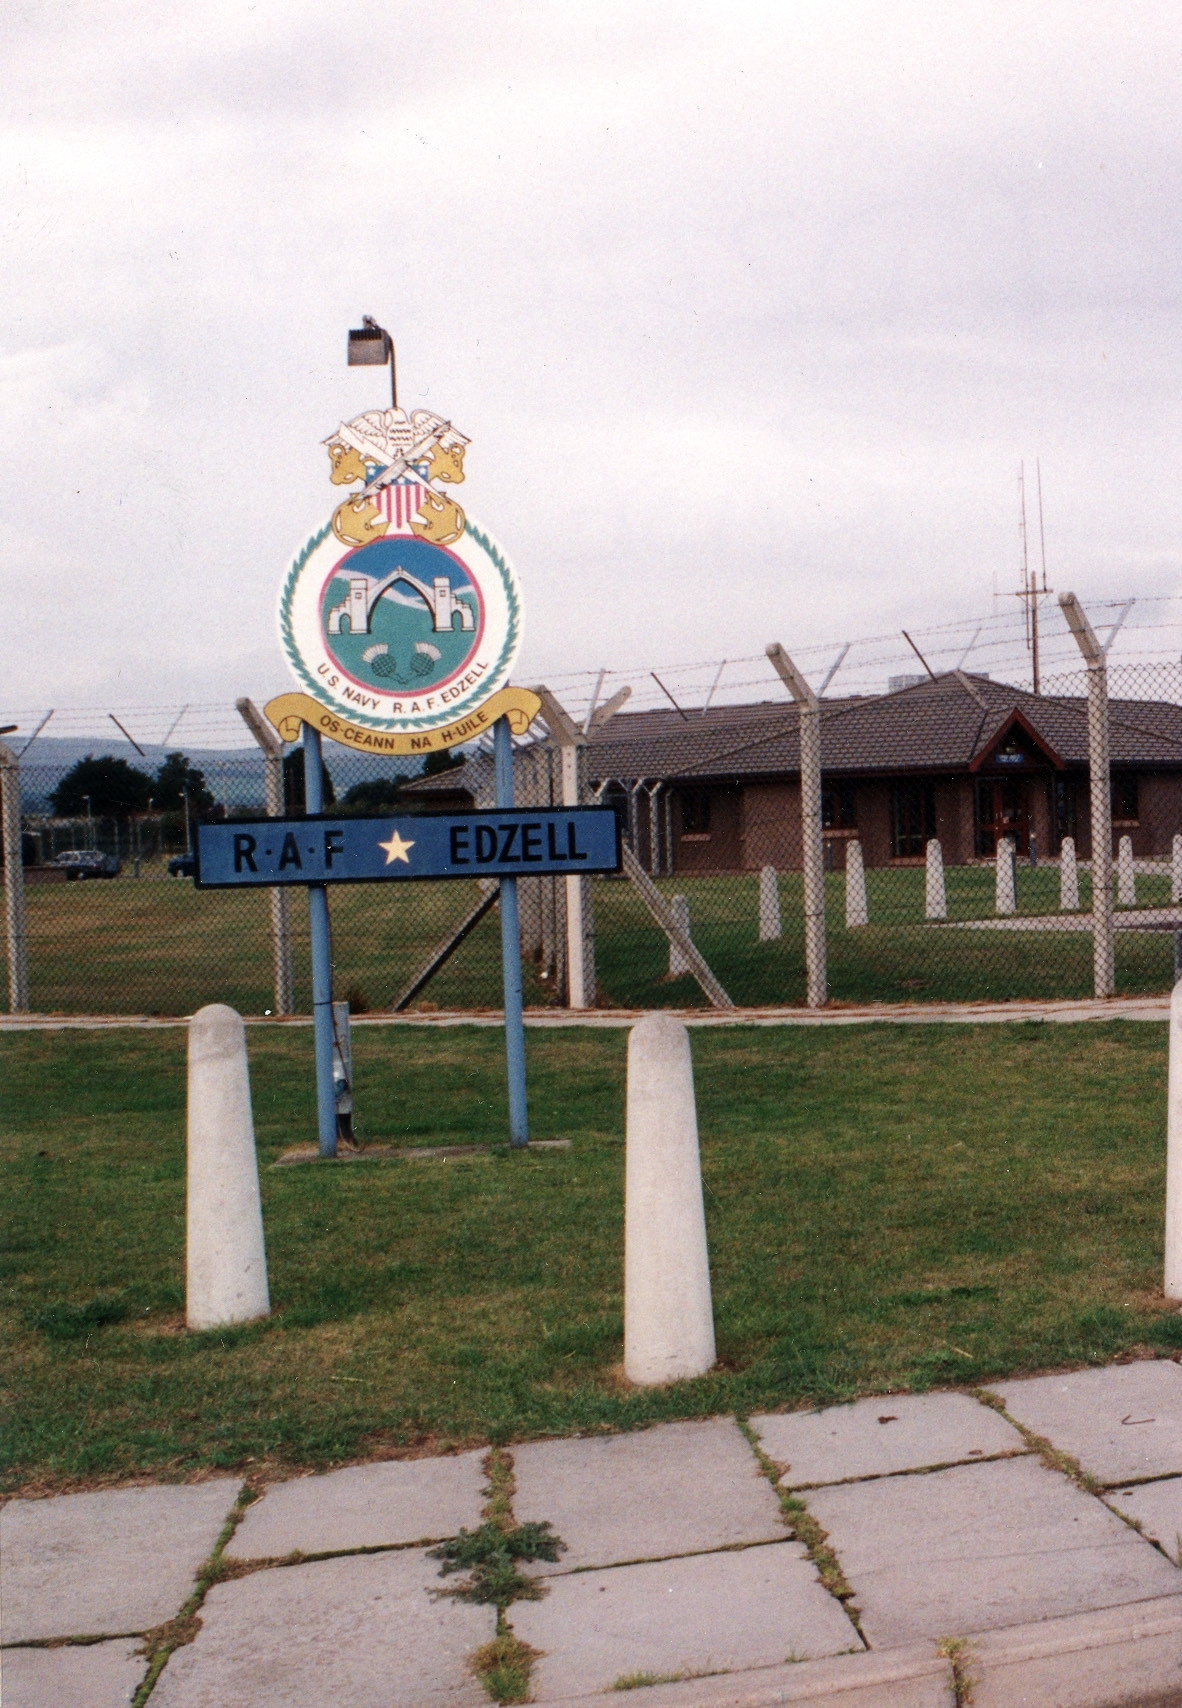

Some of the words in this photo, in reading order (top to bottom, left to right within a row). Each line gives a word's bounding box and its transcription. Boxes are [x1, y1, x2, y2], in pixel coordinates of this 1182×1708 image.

[317, 663, 340, 690] U.S.
[342, 686, 380, 710] NAVY
[441, 661, 489, 703] EDZELL
[319, 715, 395, 749] OS-CEANN
[411, 737, 432, 749] NA
[441, 711, 489, 743] H-UILE
[449, 822, 588, 865] EDZELL
